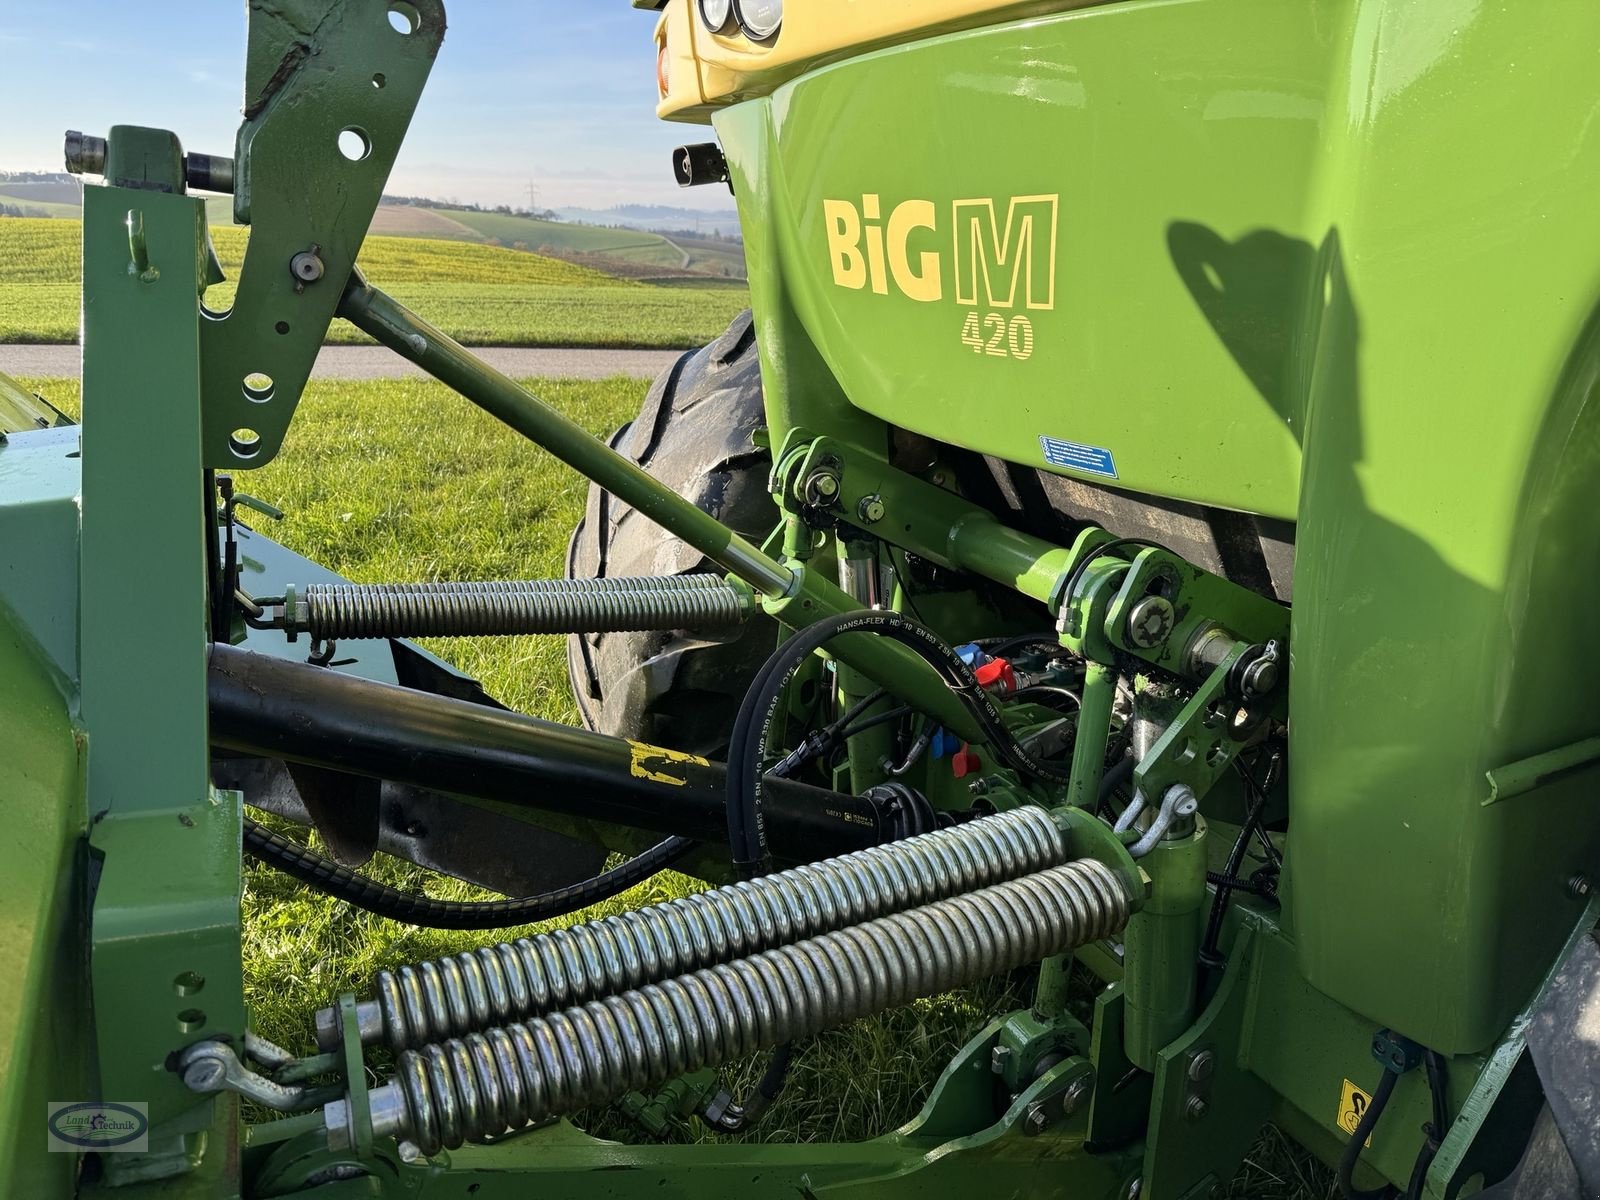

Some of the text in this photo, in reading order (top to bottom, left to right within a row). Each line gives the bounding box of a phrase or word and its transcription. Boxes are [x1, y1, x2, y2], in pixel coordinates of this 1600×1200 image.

[952, 193, 1059, 310] M
[961, 311, 1034, 361] 420
[836, 617, 886, 633] HANSA-FLEX
[915, 627, 926, 638] EN
[925, 633, 937, 645] 853
[942, 647, 952, 658] SN
[952, 657, 960, 667] 10
[974, 685, 985, 701] BAR
[767, 695, 779, 718] BAR
[761, 718, 771, 735] 330
[757, 738, 766, 755] WP
[756, 762, 763, 774] 10
